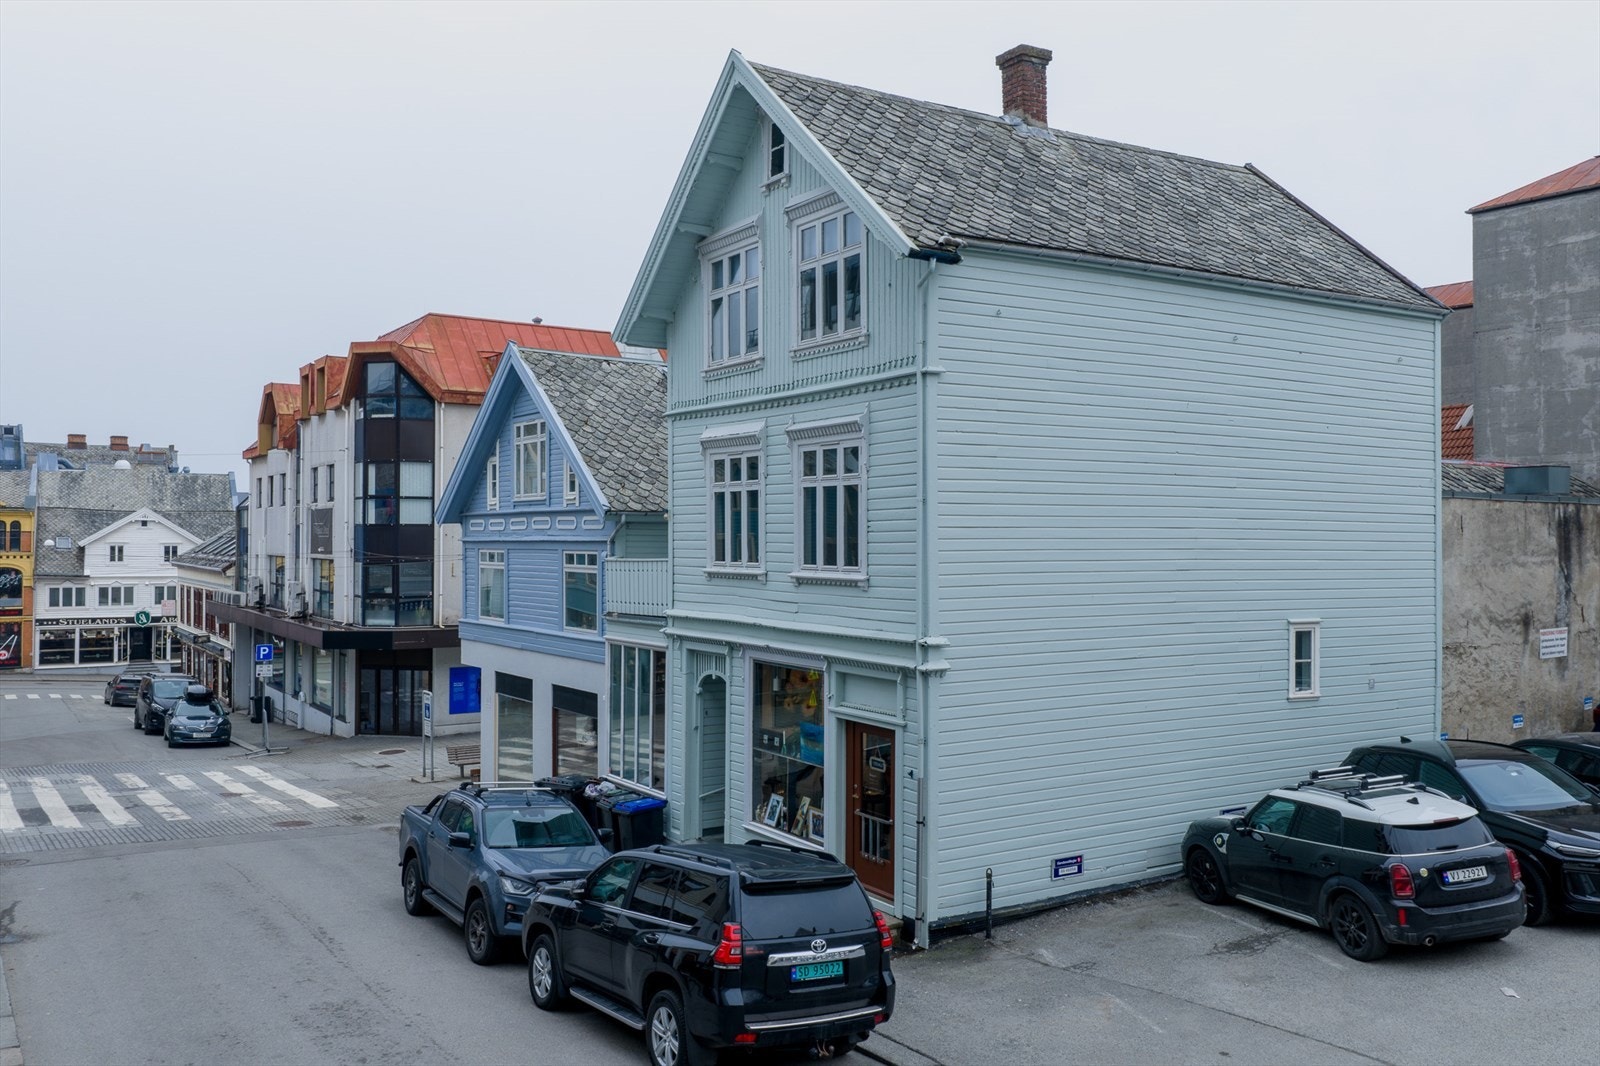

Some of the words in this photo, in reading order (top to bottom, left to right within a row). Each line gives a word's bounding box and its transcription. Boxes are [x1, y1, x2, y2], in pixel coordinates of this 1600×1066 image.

[260, 646, 269, 659] P
[1449, 871, 1459, 880] VJ
[1461, 868, 1485, 878] 22921
[798, 966, 810, 977] SD
[813, 963, 841, 975] 95022
